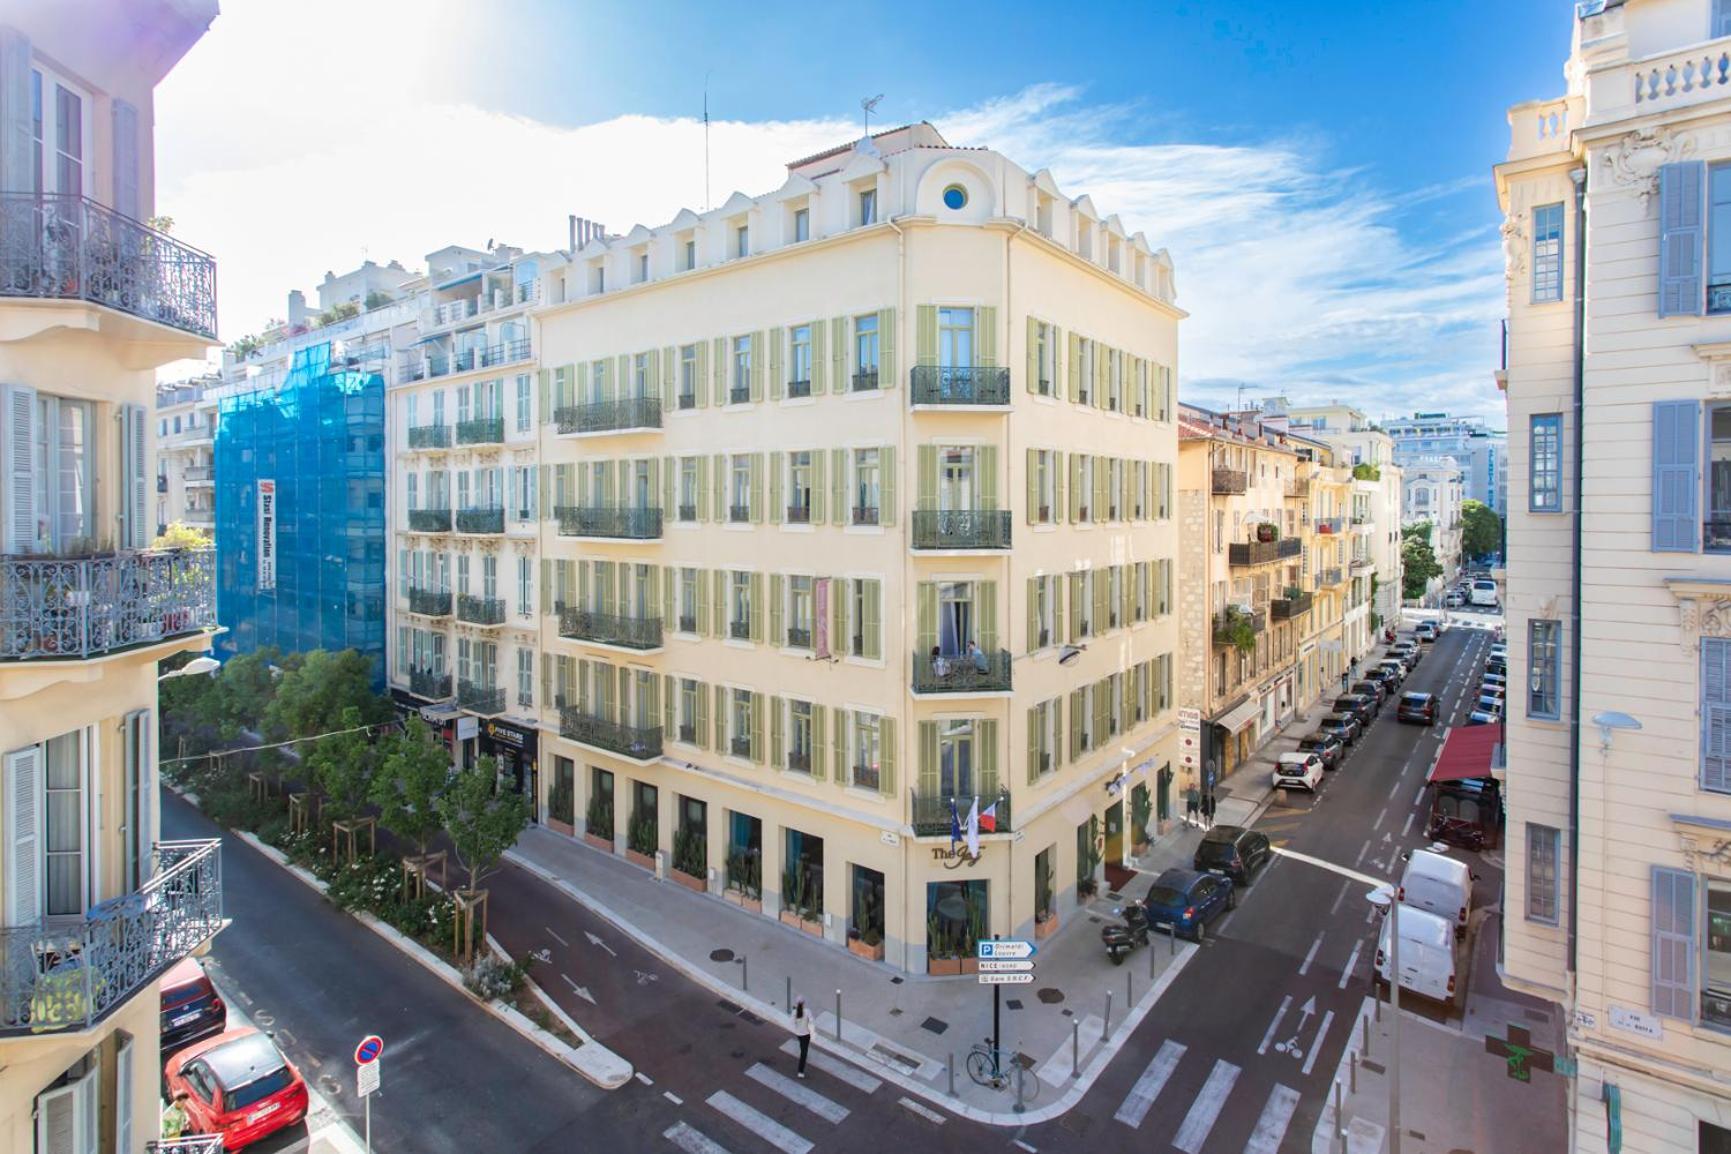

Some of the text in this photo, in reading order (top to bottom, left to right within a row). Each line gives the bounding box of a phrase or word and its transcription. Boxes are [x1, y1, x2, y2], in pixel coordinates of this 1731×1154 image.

[263, 495, 272, 514] Stasi
[507, 730, 524, 740] STARS
[931, 847, 955, 859] The
